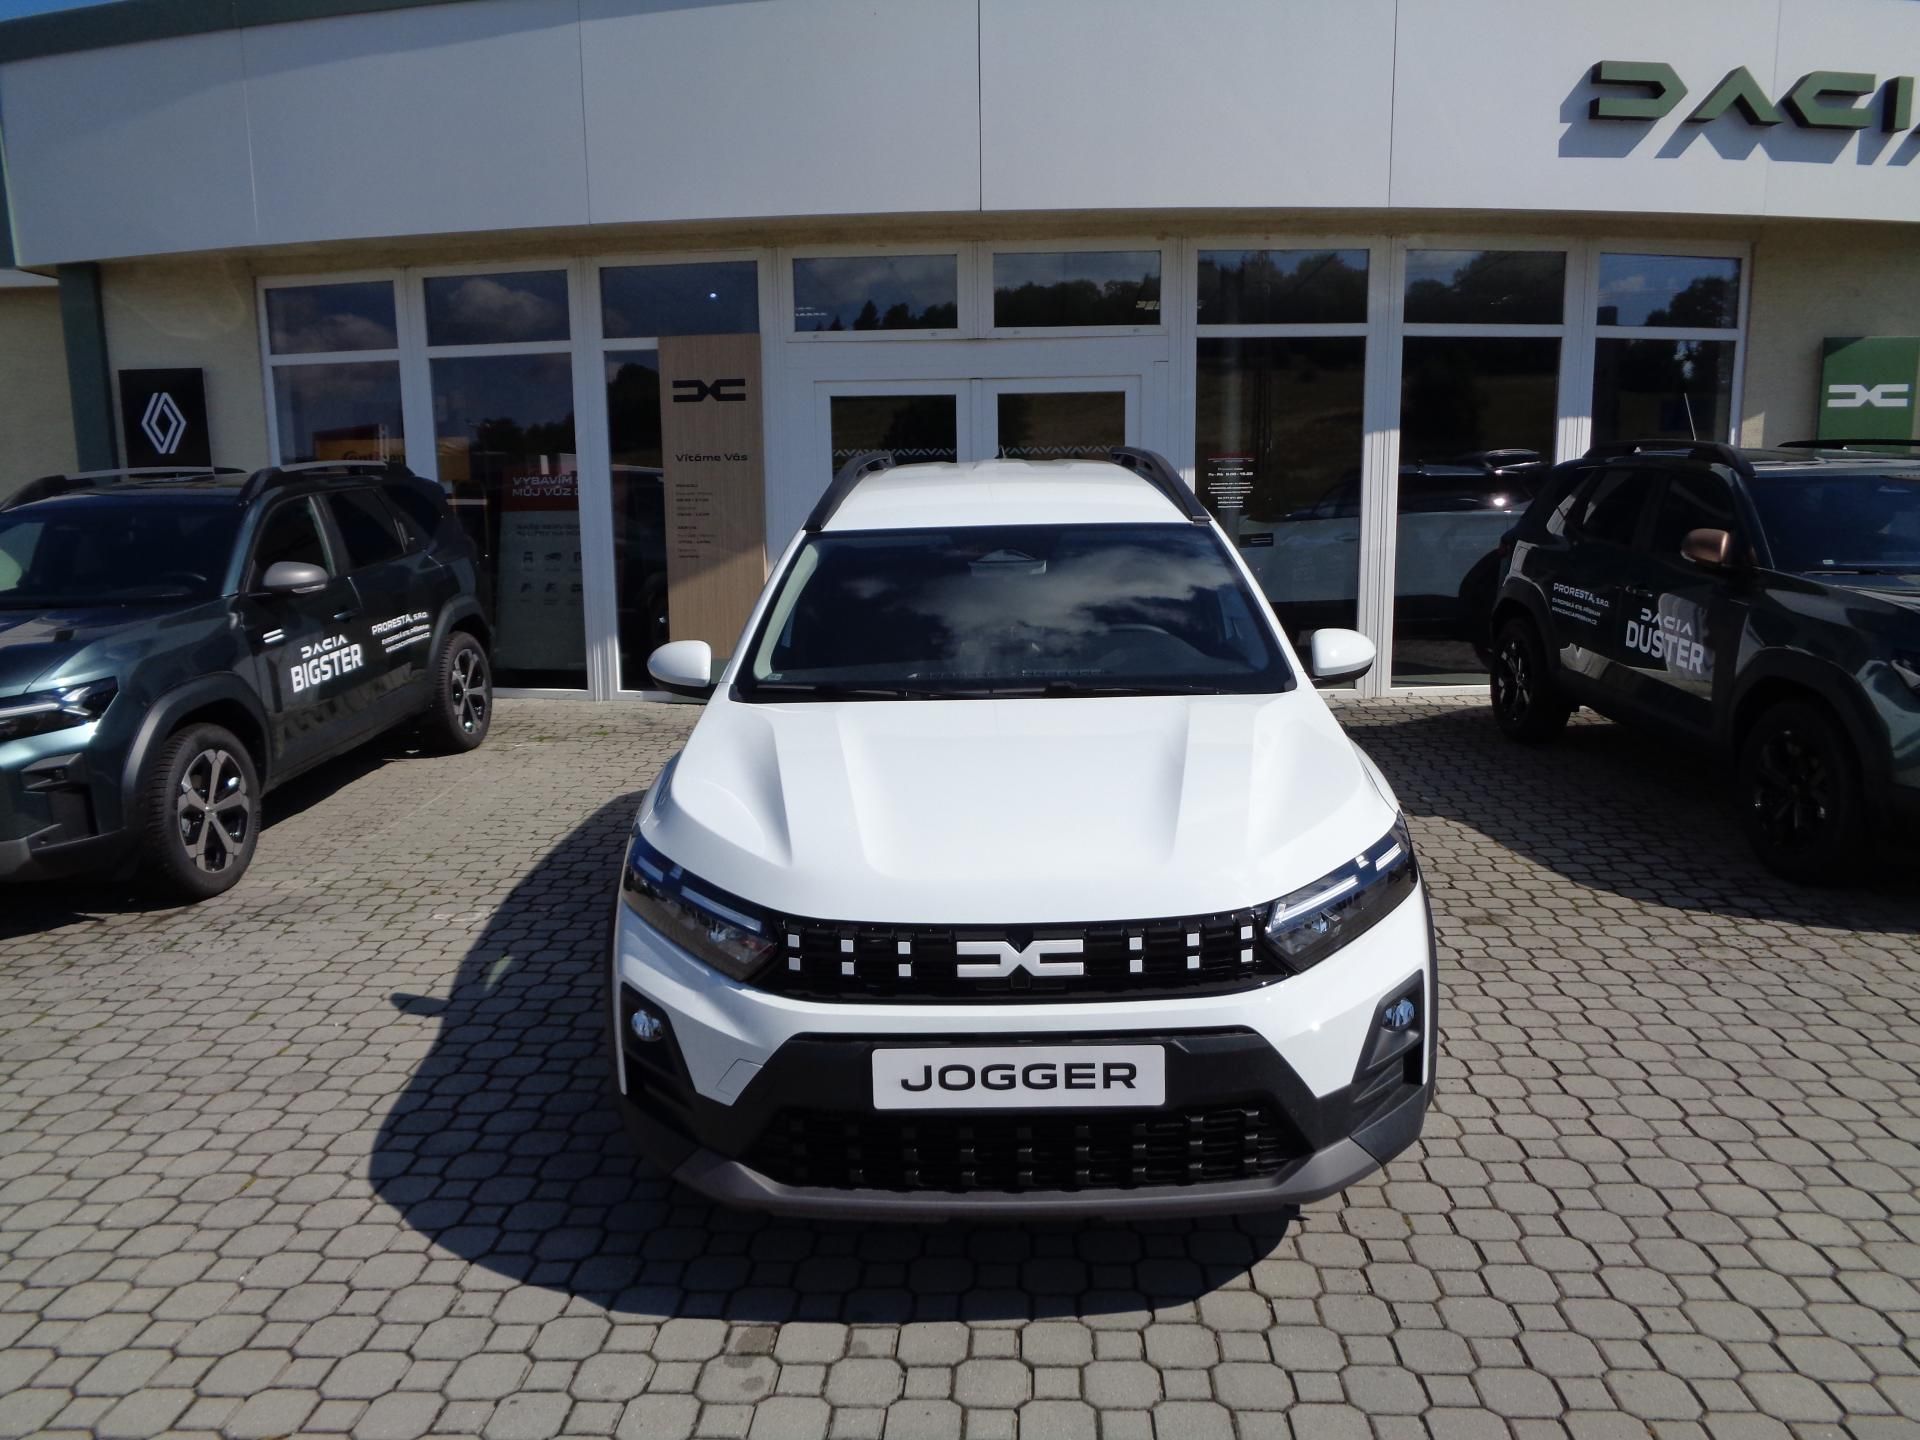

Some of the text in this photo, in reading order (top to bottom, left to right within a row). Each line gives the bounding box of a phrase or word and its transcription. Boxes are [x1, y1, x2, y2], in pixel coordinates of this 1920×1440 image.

[1588, 60, 1920, 136] DACI
[675, 453, 749, 463] Vítáme Vás
[512, 485, 541, 497] MŮJ
[513, 475, 573, 486] VYBAVÍM
[1640, 607, 1693, 636] DACIA
[300, 634, 348, 659] DACIA
[1625, 619, 1705, 674] DUSTER
[290, 643, 363, 693] BIGSTER
[900, 1062, 1137, 1092] JOGGER
